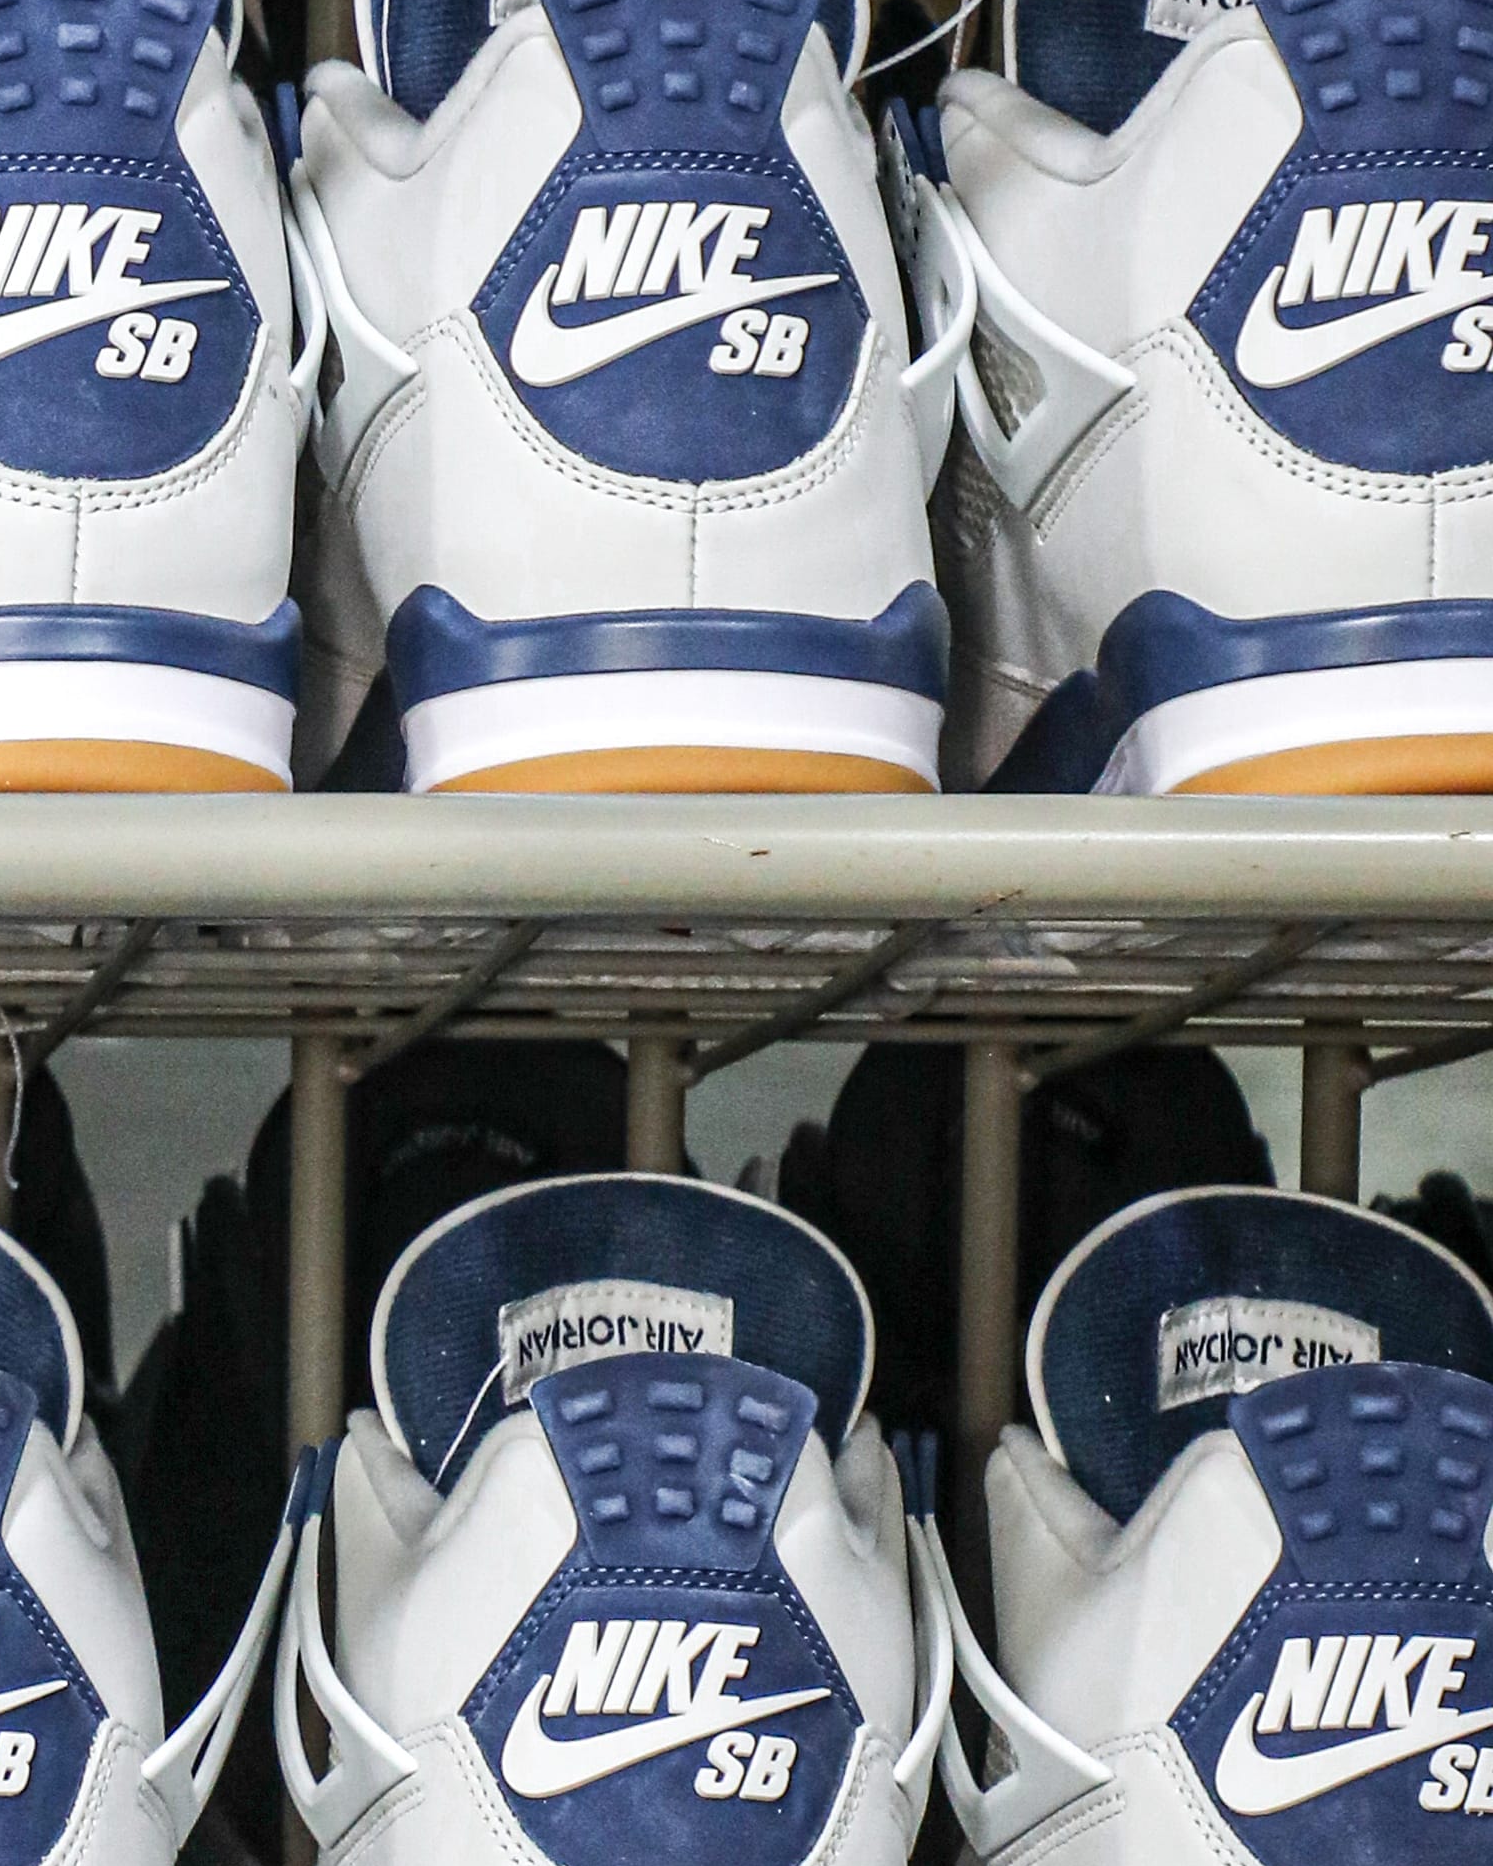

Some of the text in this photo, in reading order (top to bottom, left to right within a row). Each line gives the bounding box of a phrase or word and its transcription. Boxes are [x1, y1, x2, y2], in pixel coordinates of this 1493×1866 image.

[551, 201, 770, 303] NIKE
[1278, 199, 1493, 305] NIKE
[93, 310, 200, 385] SB
[706, 306, 811, 379] SB
[1439, 303, 1493, 374] S
[646, 1316, 704, 1353] AIR
[543, 1619, 760, 1717] NIKE
[1256, 1633, 1475, 1734] NIKE
[692, 1729, 799, 1801] SB
